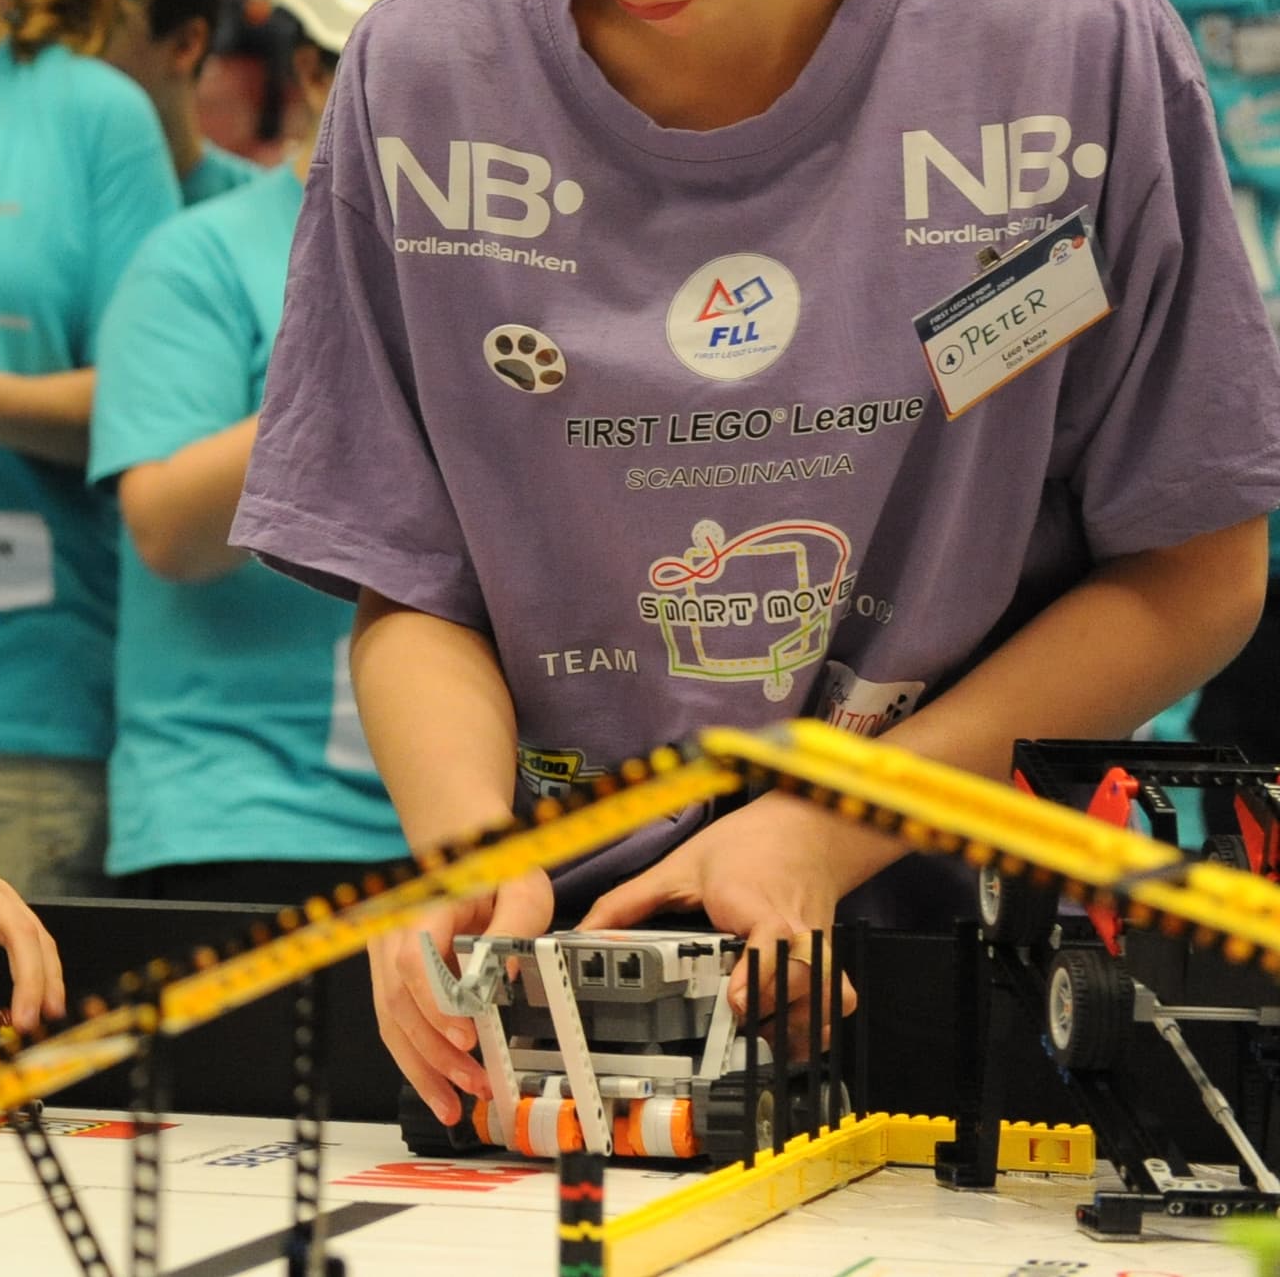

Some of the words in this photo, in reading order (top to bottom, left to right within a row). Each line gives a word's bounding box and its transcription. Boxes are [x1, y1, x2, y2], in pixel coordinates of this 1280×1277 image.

[394, 236, 577, 274] ordlandsBanken
[709, 321, 760, 348] FLL
[960, 288, 1048, 356] PETER
[945, 353, 956, 366] 4
[566, 416, 660, 448] FIRST
[791, 396, 925, 436] League
[625, 453, 855, 490] SCANDINAVIA
[639, 592, 756, 625] SMART
[764, 571, 857, 623] MOVE
[539, 647, 638, 678] TEAM
